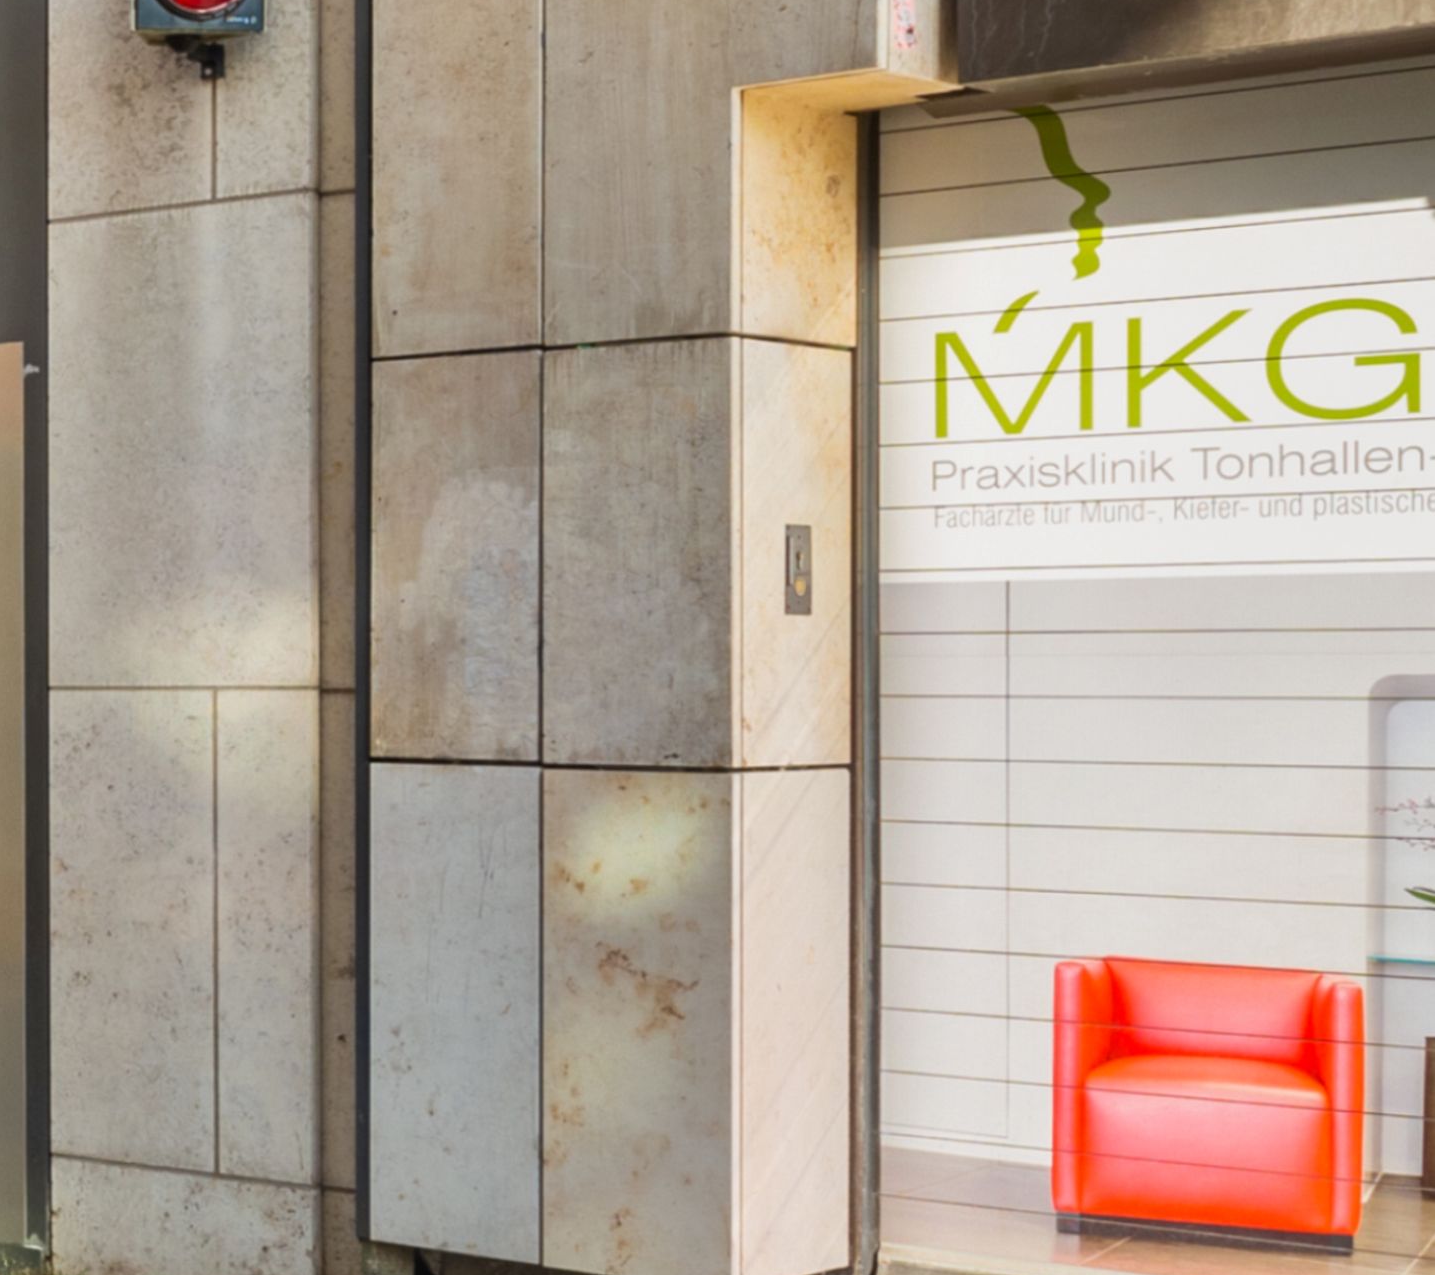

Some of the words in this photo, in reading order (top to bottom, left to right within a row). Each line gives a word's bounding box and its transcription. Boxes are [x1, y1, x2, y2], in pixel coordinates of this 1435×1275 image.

[935, 297, 1421, 438] MKG
[931, 450, 1175, 492] Praxisklinik
[1190, 440, 1435, 481] Tonhallen-
[1258, 492, 1303, 519] und
